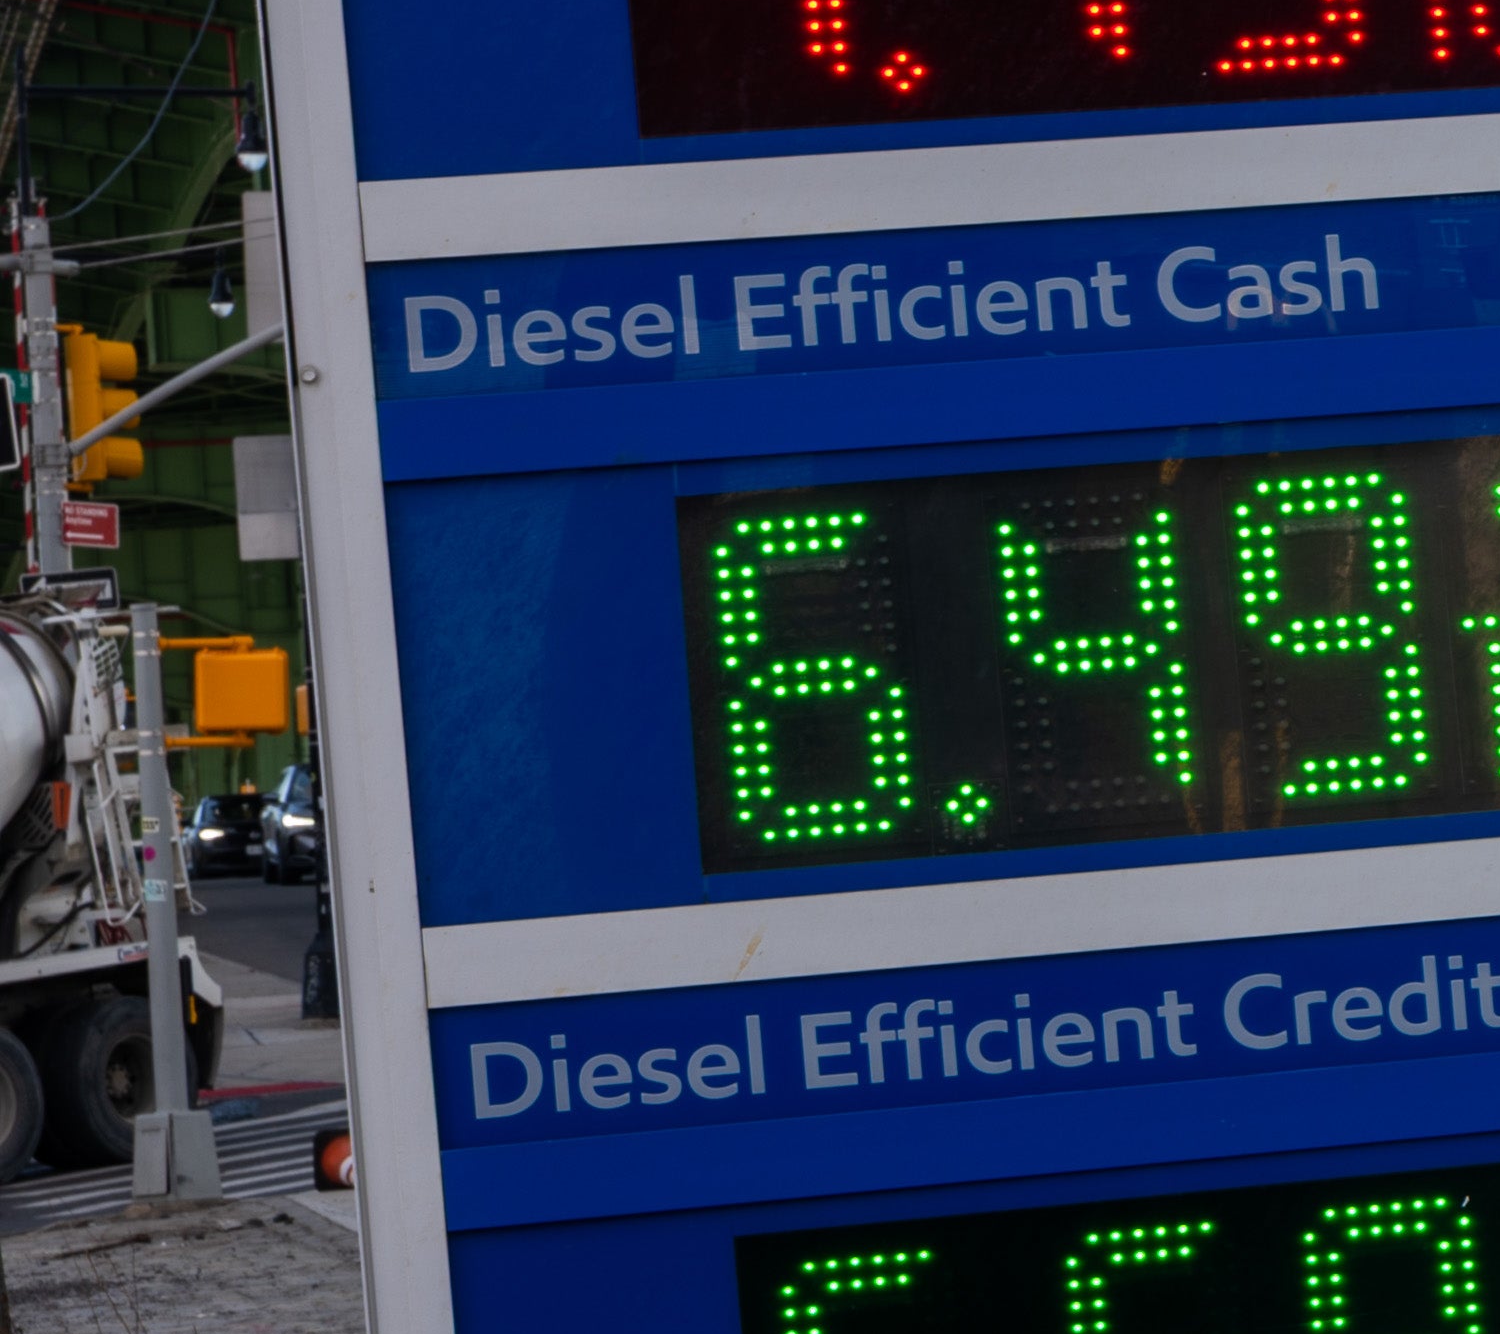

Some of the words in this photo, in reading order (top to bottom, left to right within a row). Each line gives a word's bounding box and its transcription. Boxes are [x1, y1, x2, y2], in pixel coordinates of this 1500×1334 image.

[404, 274, 700, 373] Diesel
[734, 261, 1131, 351] Efficient
[1157, 234, 1378, 322] Cash
[712, 471, 1429, 842] 6.49
[470, 1013, 764, 1119] Diesel
[800, 989, 1197, 1088] Efficient
